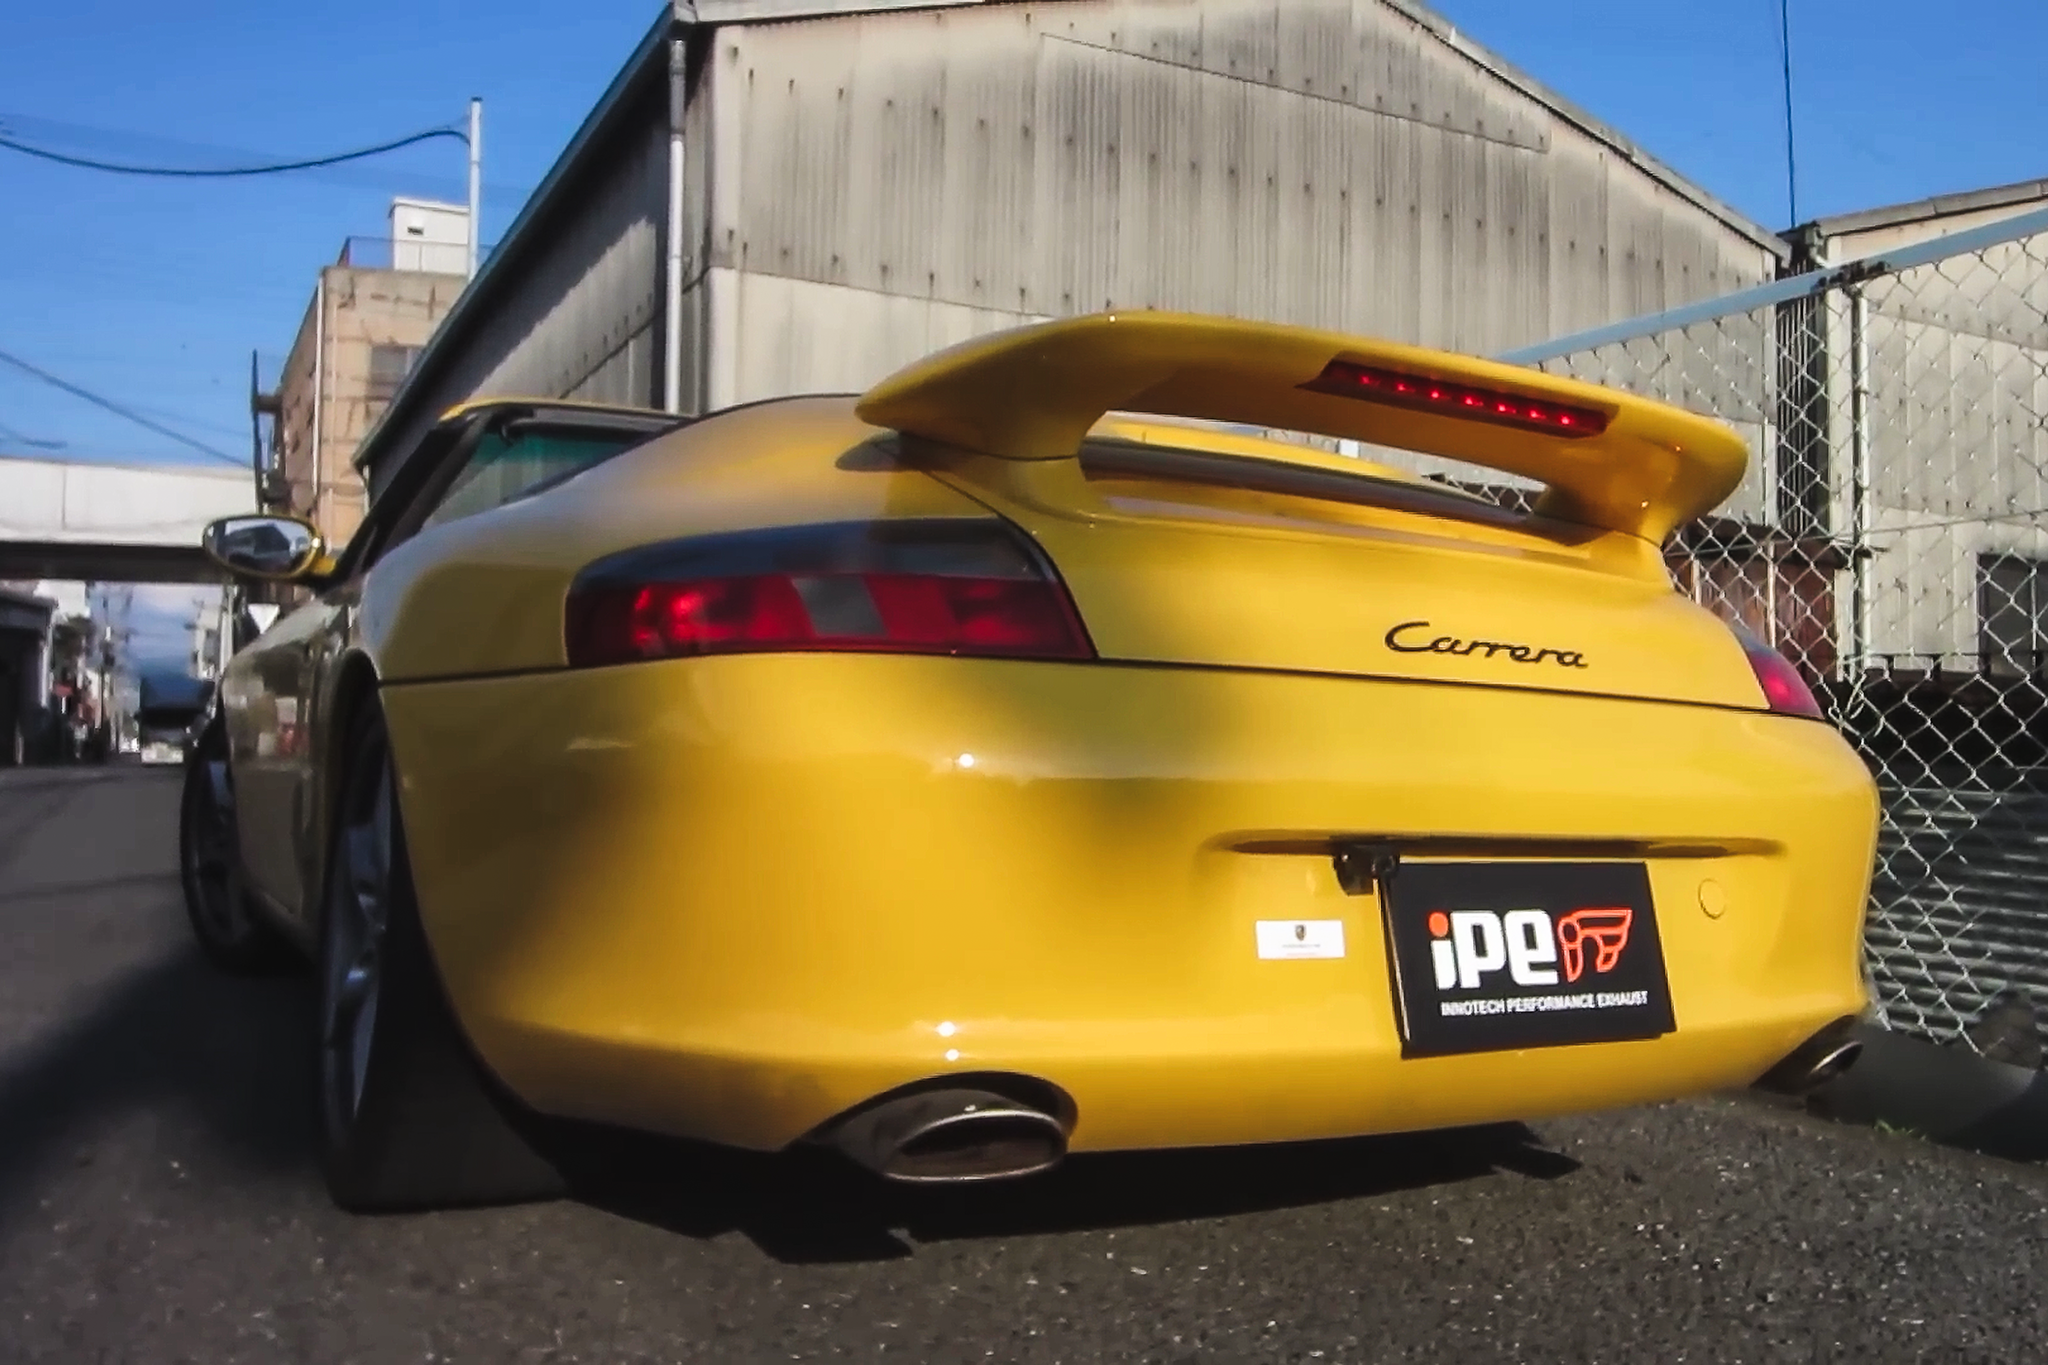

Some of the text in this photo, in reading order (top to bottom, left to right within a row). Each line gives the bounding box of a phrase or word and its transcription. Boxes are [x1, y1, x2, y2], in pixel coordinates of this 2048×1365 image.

[1384, 620, 1588, 669] Carrera
[1440, 990, 1649, 1017] INNOTECH PERFORMANCE EXHAUST
